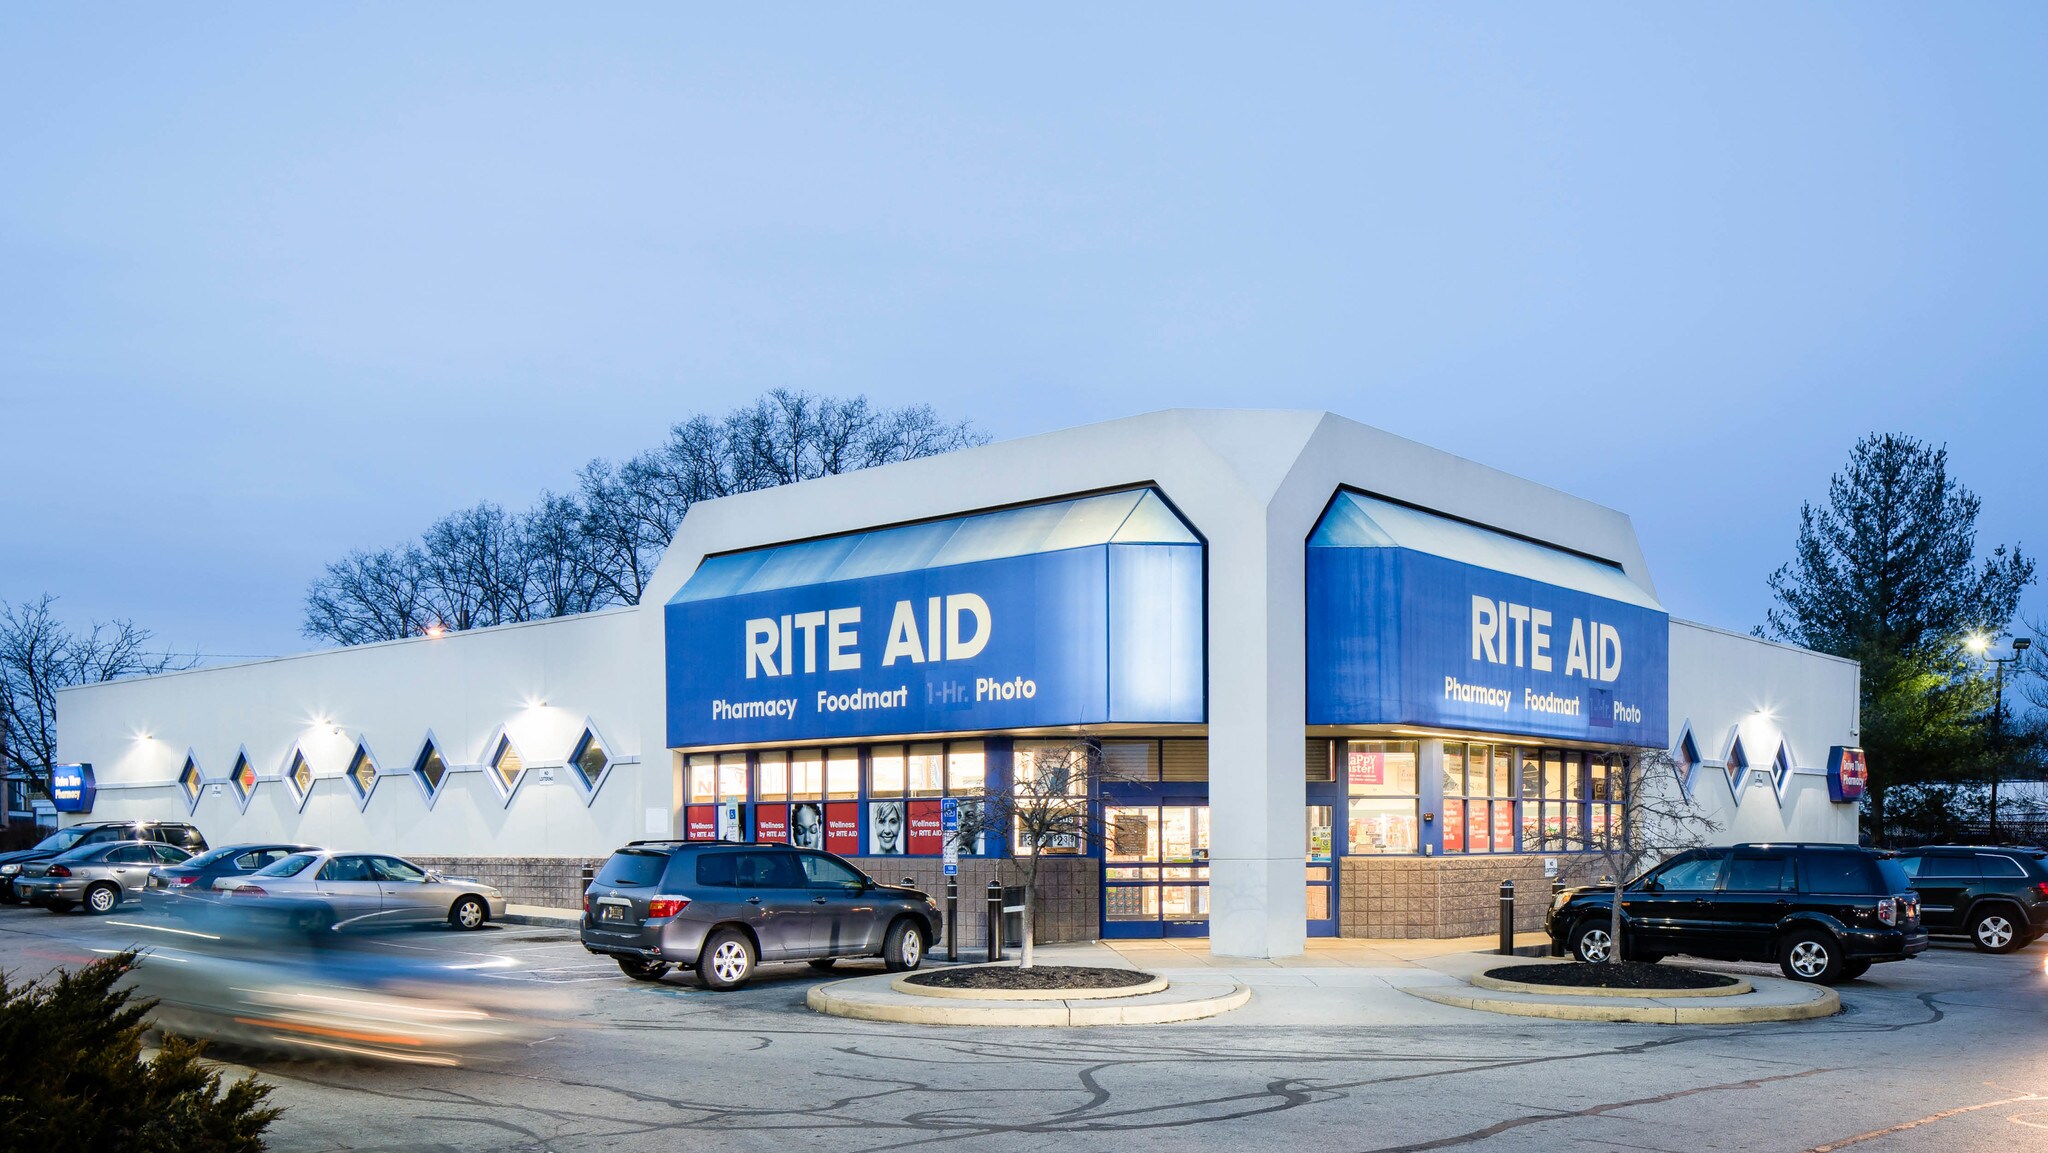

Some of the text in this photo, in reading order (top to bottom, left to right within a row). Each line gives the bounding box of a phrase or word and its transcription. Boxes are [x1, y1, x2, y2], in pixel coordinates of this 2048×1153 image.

[746, 592, 991, 679] RITE AID
[1472, 594, 1622, 682] RITE AID
[712, 676, 1036, 720] Pharmacy Foodmart 1-Hr. Photo
[1445, 676, 1511, 712] Pharmacy
[1525, 688, 1580, 715] Foodmart
[1613, 701, 1641, 723] Photo
[1843, 774, 1864, 788] Pharmacy
[55, 788, 81, 800] Pharmacy
[691, 822, 713, 830] Wellness
[760, 821, 784, 829] Wellness
[829, 820, 855, 828] Wellness
[911, 819, 940, 828] Wellness
[828, 830, 835, 838] by
[918, 829, 931, 837] RITE
[932, 829, 942, 837] AID
